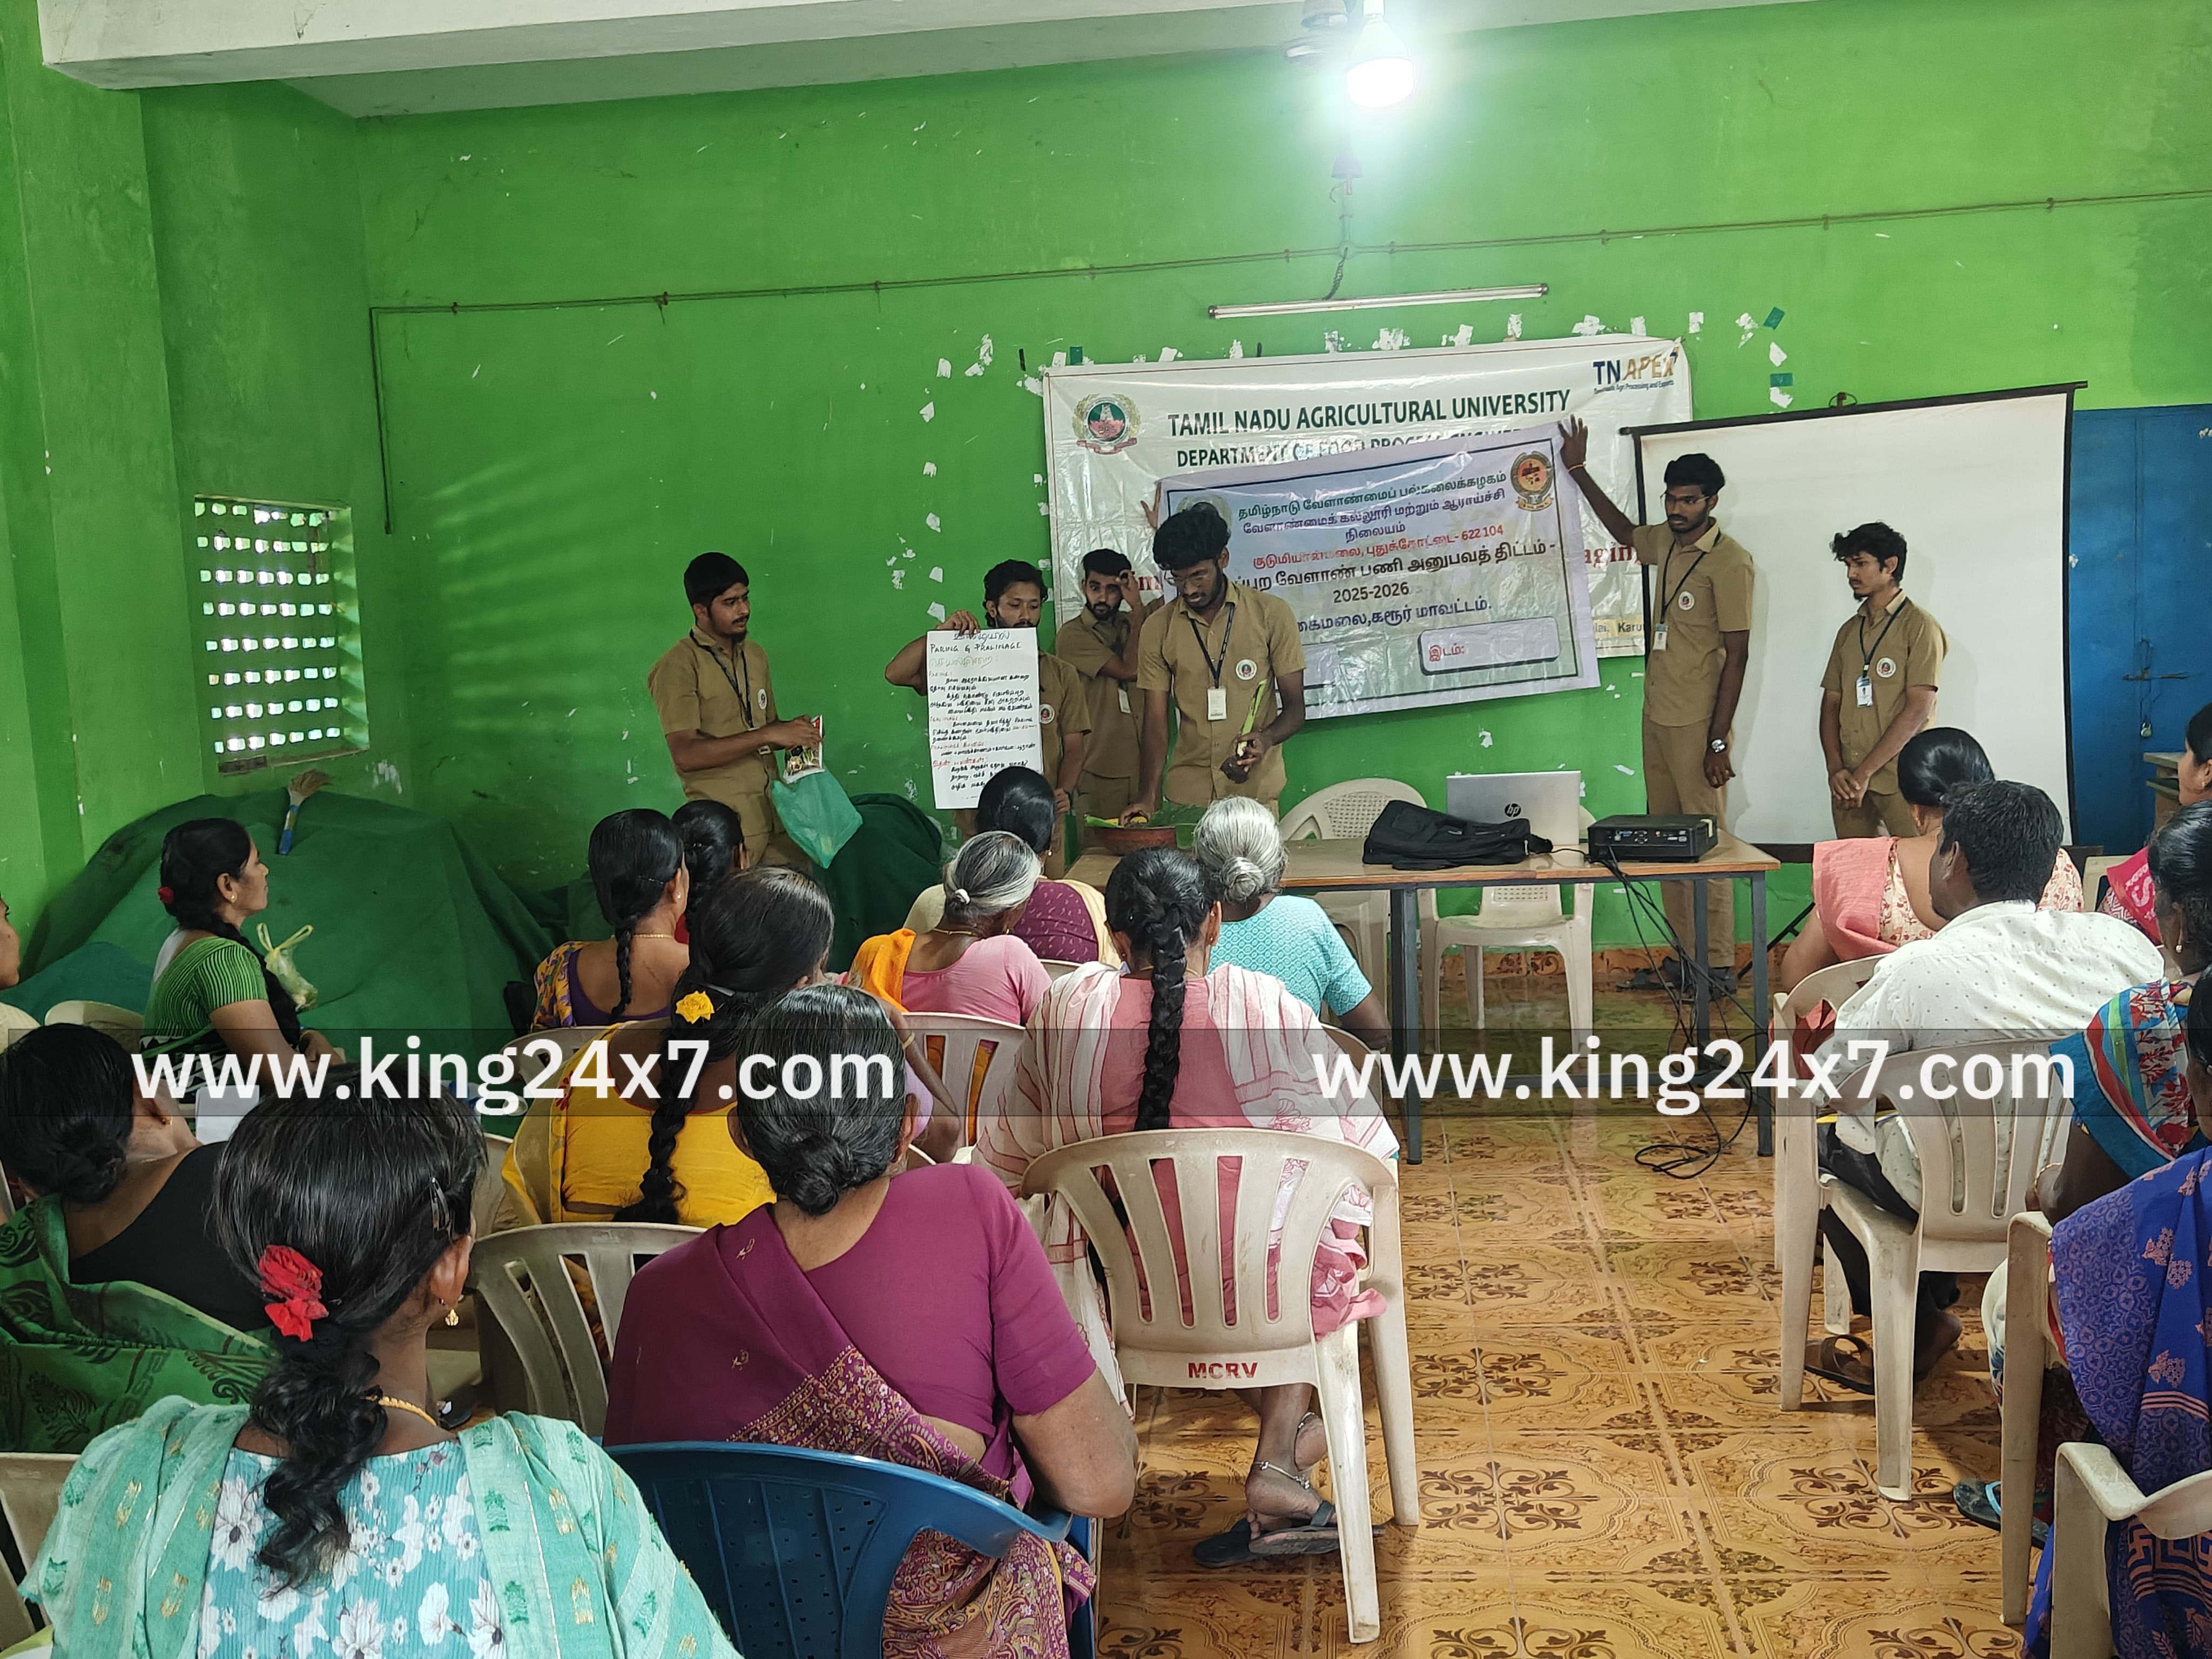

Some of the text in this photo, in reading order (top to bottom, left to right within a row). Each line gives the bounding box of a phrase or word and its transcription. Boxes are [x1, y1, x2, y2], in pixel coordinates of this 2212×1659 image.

[1168, 389, 1571, 437] TAMIL NADU AGRICULTURAL UNIVERSITY
[1238, 470, 1507, 521] தமிழ்நாடு வேளாண்மைப் பல்கலைக்கழகம்
[1243, 512, 1338, 534] வேளாண்மைக்
[1394, 499, 1439, 518] மற்றும்
[1442, 488, 1506, 511] ஆராய்ச்சி
[1345, 521, 1406, 543] நிலையம்
[1461, 528, 1481, 541] 622
[1483, 524, 1504, 537] 104
[1276, 564, 1357, 586] வேளாண்
[1361, 557, 1403, 577] பணி
[1407, 545, 1492, 572] அனுபவத்
[1333, 582, 1410, 604] 2025-2026
[1618, 622, 1643, 633] Karu
[1428, 643, 1465, 662] இடம்:
[1506, 803, 1520, 817] hp
[1188, 1362, 1258, 1379] MCRV
